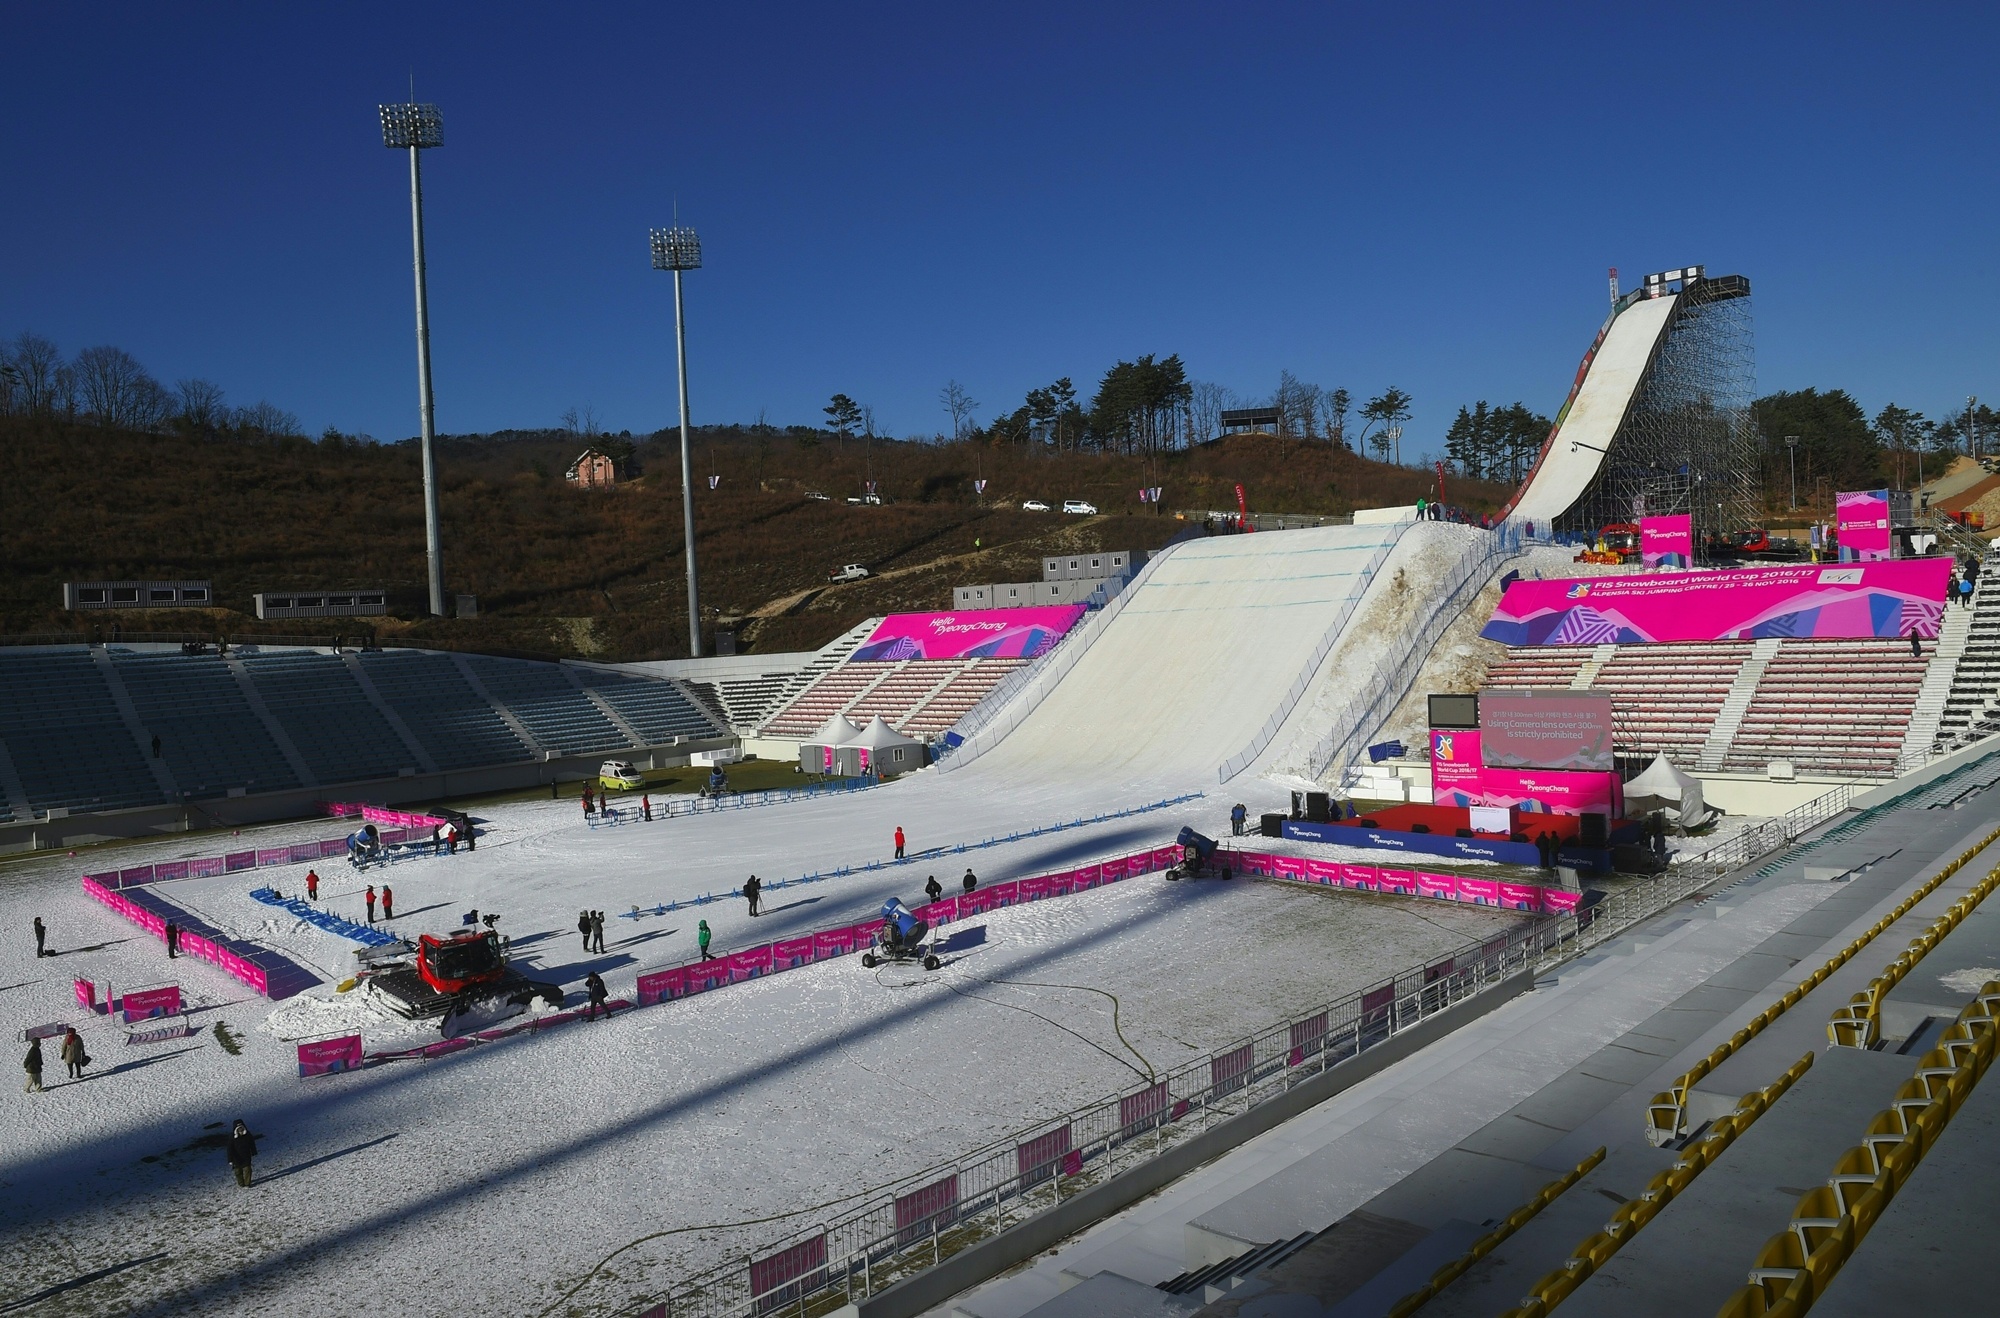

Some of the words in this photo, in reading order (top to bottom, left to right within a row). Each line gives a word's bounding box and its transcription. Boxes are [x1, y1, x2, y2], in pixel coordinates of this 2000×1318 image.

[1235, 485, 1244, 504] LOTTE
[1650, 531, 1687, 539] PyeongChang
[1614, 578, 1690, 588] Snowboard
[1691, 574, 1731, 583] World
[1732, 573, 1758, 582] Cup
[1760, 570, 1815, 579] 2016/17
[1645, 587, 1683, 595] JUMPING
[1684, 584, 1717, 592] CENTRE
[929, 616, 955, 628] Hello
[934, 621, 1008, 636] PyeongChang
[1487, 719, 1509, 730] Using
[1509, 720, 1541, 729] Camera
[1541, 720, 1558, 729] lens
[1577, 721, 1603, 730] 300mm
[1507, 729, 1514, 738] is
[1514, 730, 1541, 740] strictly
[1541, 730, 1583, 740] prohibited
[1527, 784, 1569, 793] PyeongChang
[1294, 830, 1321, 838] PyeongChang
[1374, 838, 1403, 847] PyeongChang
[1462, 847, 1494, 856] PyeongChang
[1558, 856, 1593, 866] PyeongChang
[1466, 885, 1491, 893] PyeongChang
[1508, 890, 1534, 898] PyeongChang
[138, 995, 172, 1005] PyeongChang
[315, 1046, 353, 1057] PyeongChang
